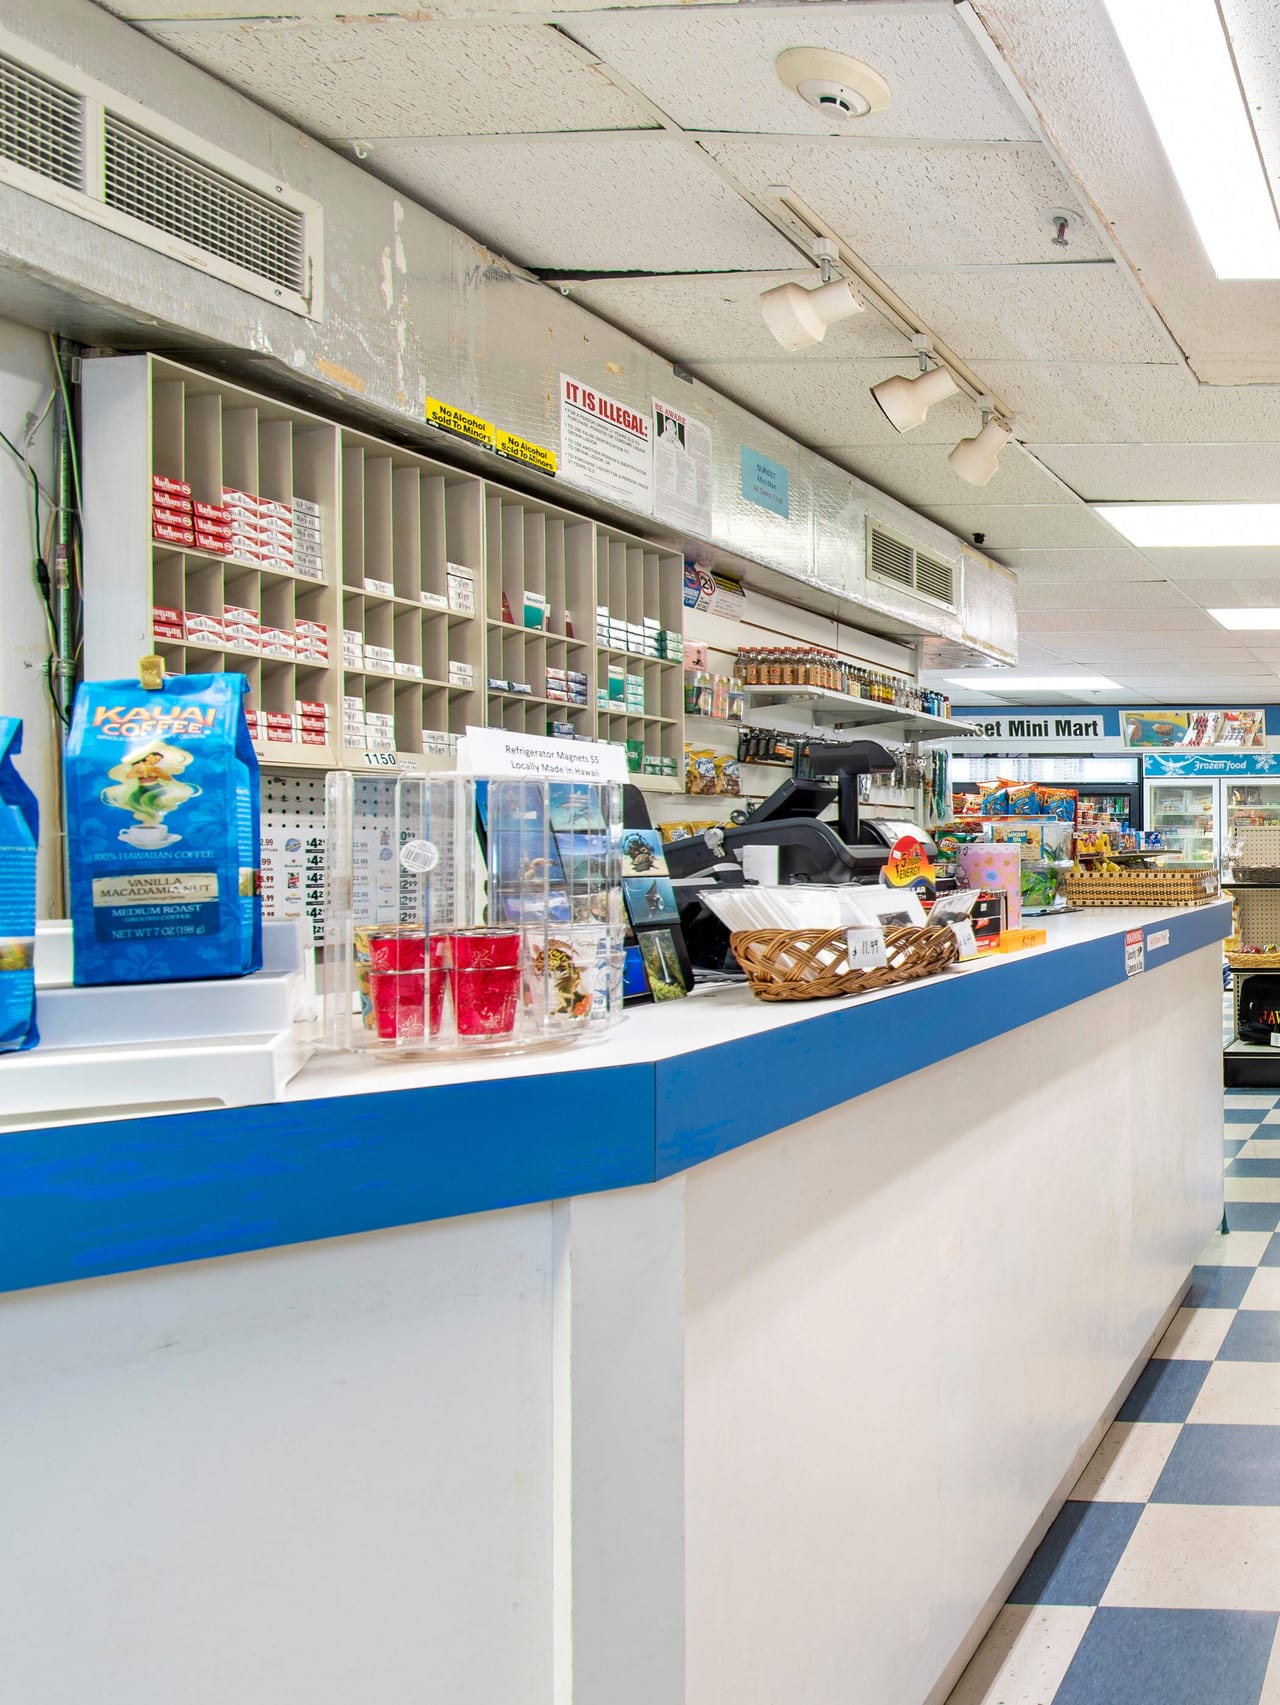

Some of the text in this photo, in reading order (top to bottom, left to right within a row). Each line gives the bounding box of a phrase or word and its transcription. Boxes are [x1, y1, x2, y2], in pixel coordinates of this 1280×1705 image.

[566, 382, 647, 437] IT IS ILLEGAL:
[432, 411, 491, 443] Sold To Minors
[440, 405, 486, 432] No Alcohol
[501, 442, 554, 470] Sold To Minors
[508, 436, 548, 460] No Alcohol
[93, 706, 216, 729] KAUAI
[101, 721, 203, 738] COFFEE
[1008, 720, 1049, 737] Mini
[1055, 720, 1099, 737] Mart
[505, 745, 554, 758] Refrigerator
[557, 751, 589, 764] Magnets
[511, 760, 539, 773] Locally
[542, 763, 564, 775] Made
[1194, 760, 1247, 772] Frozen food
[119, 850, 172, 860] HAWAIIAN
[173, 849, 215, 860] COFFEE
[900, 866, 920, 880] ENERGY
[101, 884, 211, 897] MACADAMIA NUT
[127, 877, 182, 887] VANILLA
[112, 904, 202, 917] MEDIUM ROAST
[112, 930, 131, 939] NET
[132, 929, 152, 938] WT
[153, 928, 159, 936] 7
[160, 927, 175, 936] OZ
